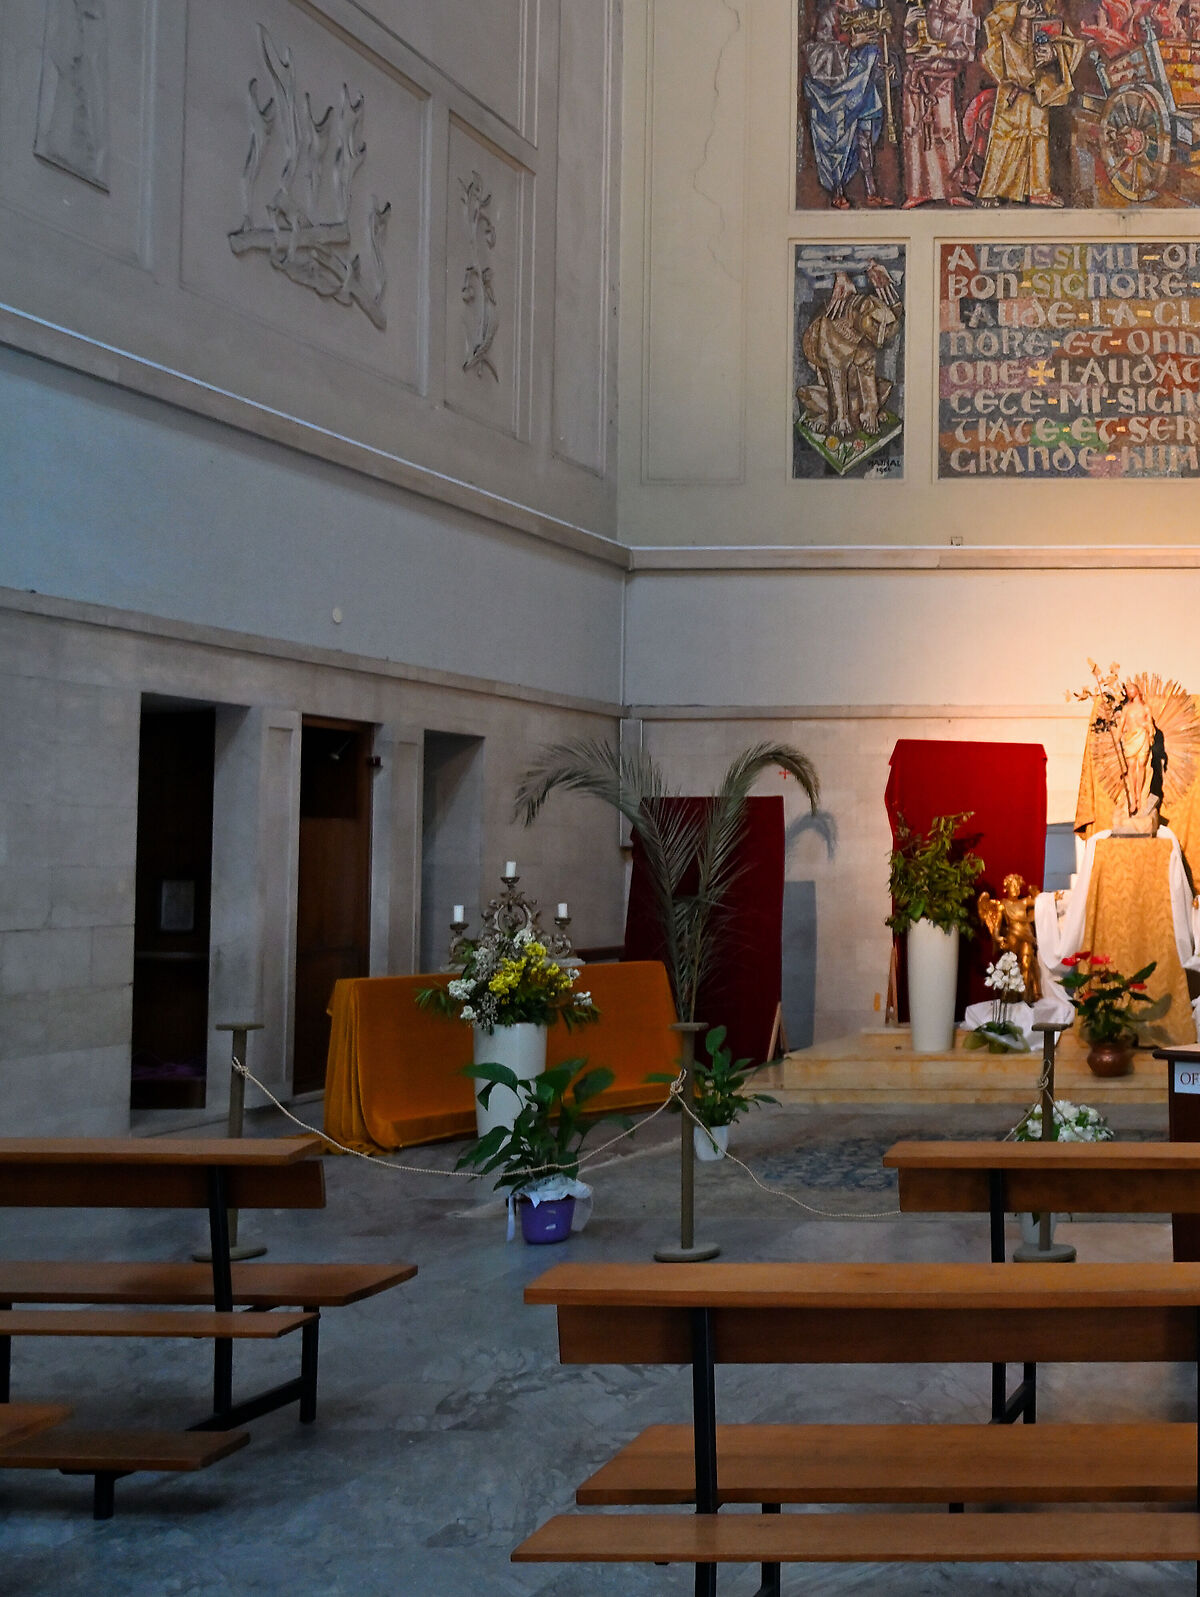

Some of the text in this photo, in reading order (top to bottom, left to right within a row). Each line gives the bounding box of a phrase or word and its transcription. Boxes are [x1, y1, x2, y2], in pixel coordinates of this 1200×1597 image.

[947, 245, 1139, 271] ALTISSIMU
[948, 273, 1018, 300] BON
[1031, 272, 1187, 299] SIGNORE
[950, 299, 1077, 328] LAUDE
[1091, 300, 1139, 327] LA
[1062, 330, 1113, 355] ET
[950, 360, 1025, 386] ONE
[1071, 416, 1119, 442] ET
